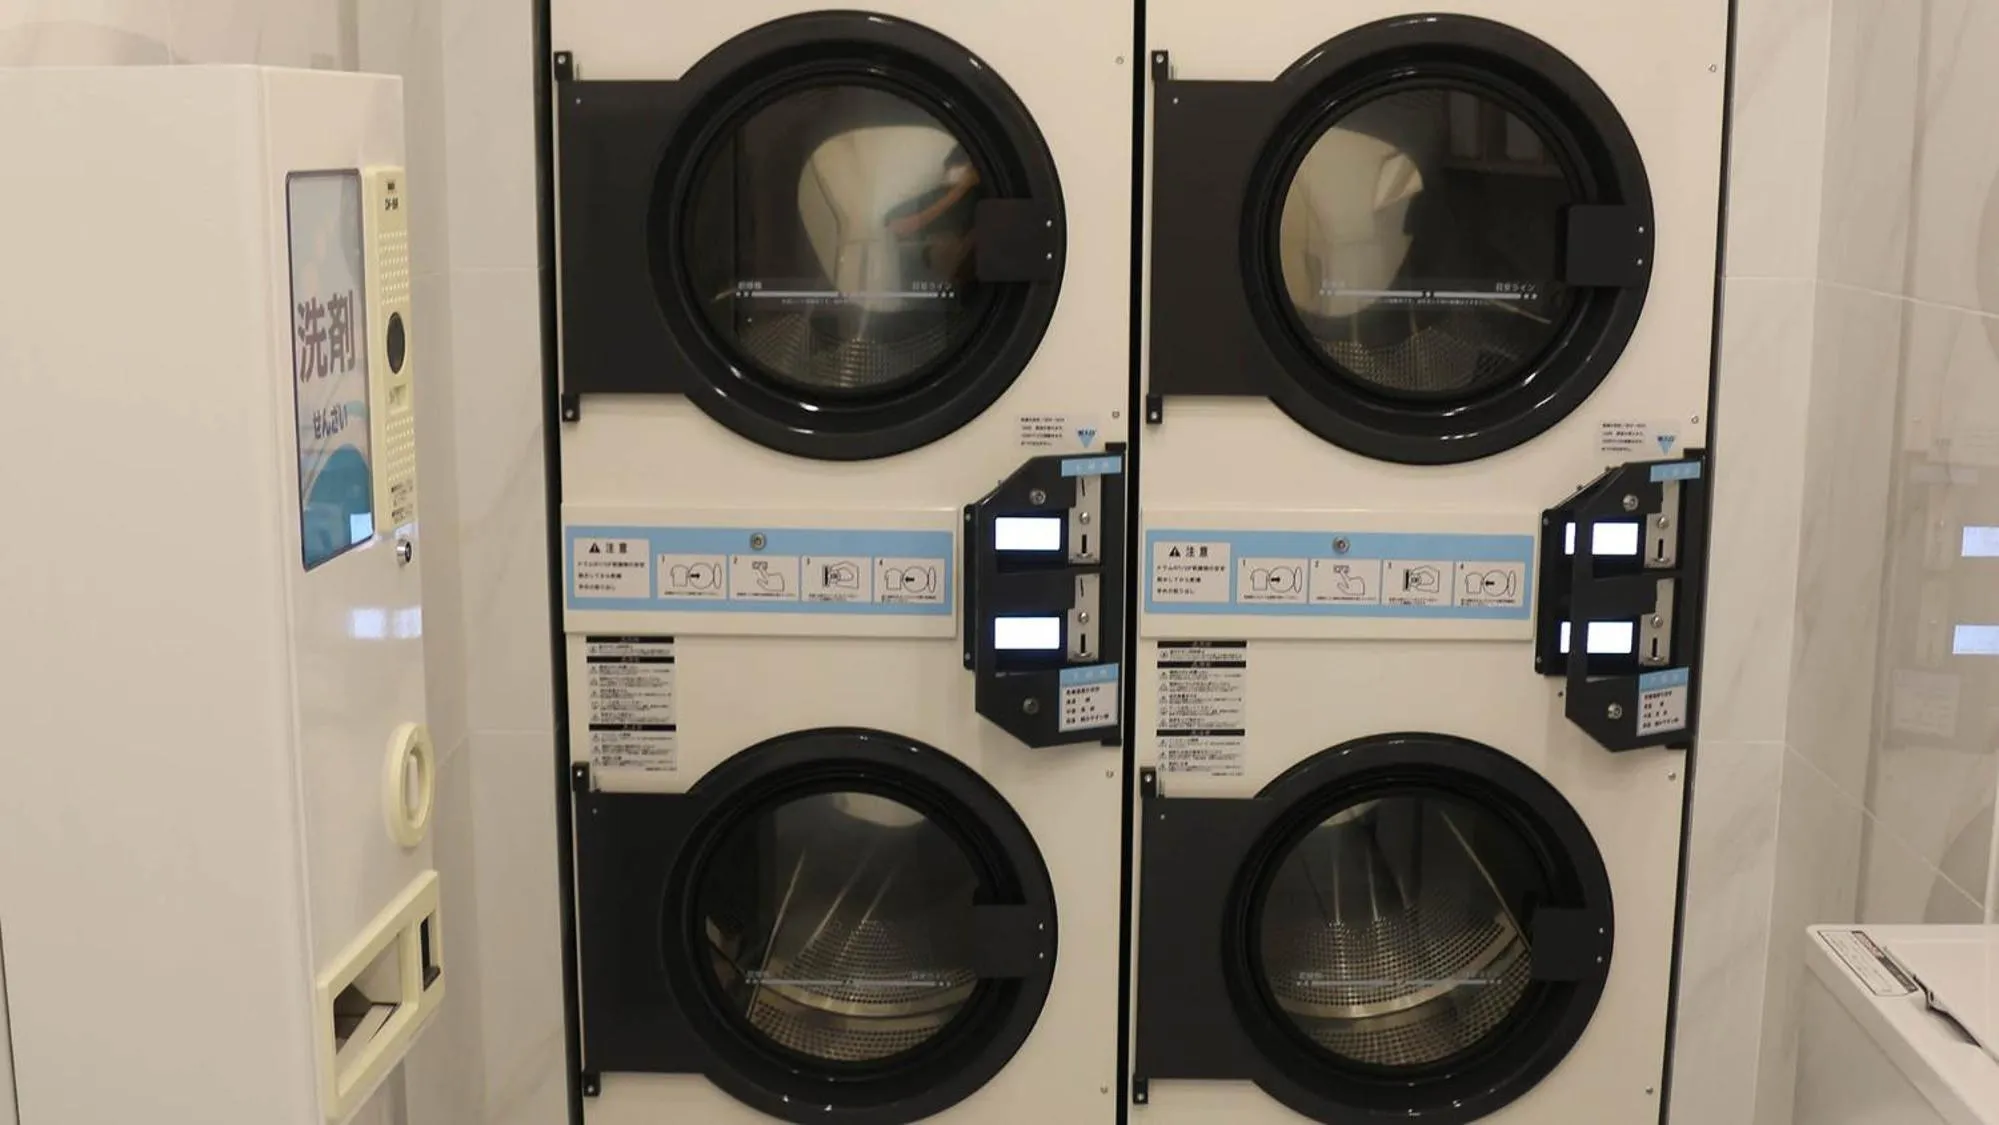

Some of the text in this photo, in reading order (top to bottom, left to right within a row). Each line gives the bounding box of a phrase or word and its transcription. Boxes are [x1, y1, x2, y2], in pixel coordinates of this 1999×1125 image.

[298, 290, 355, 383] 洗剤
[313, 404, 348, 439] せんざい
[1186, 545, 1208, 558] 注意
